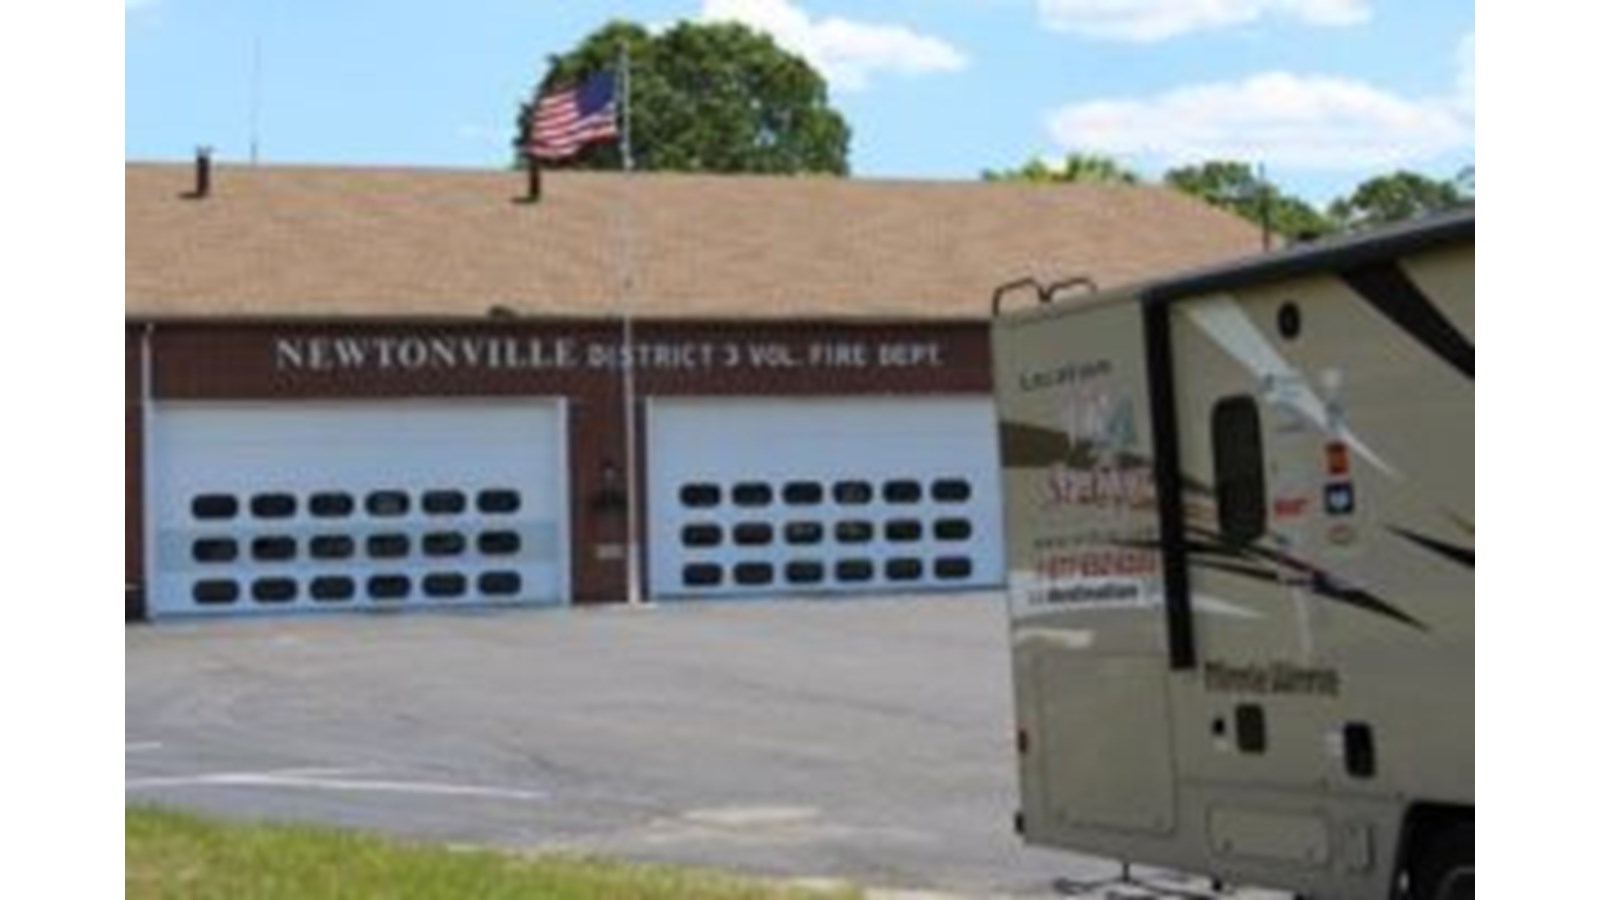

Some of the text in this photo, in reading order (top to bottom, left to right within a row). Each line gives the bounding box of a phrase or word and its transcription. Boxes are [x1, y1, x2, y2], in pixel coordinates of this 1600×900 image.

[276, 337, 579, 369] NEWTONVILLE
[586, 343, 713, 369] DISTRICT
[808, 342, 869, 367] FIRE
